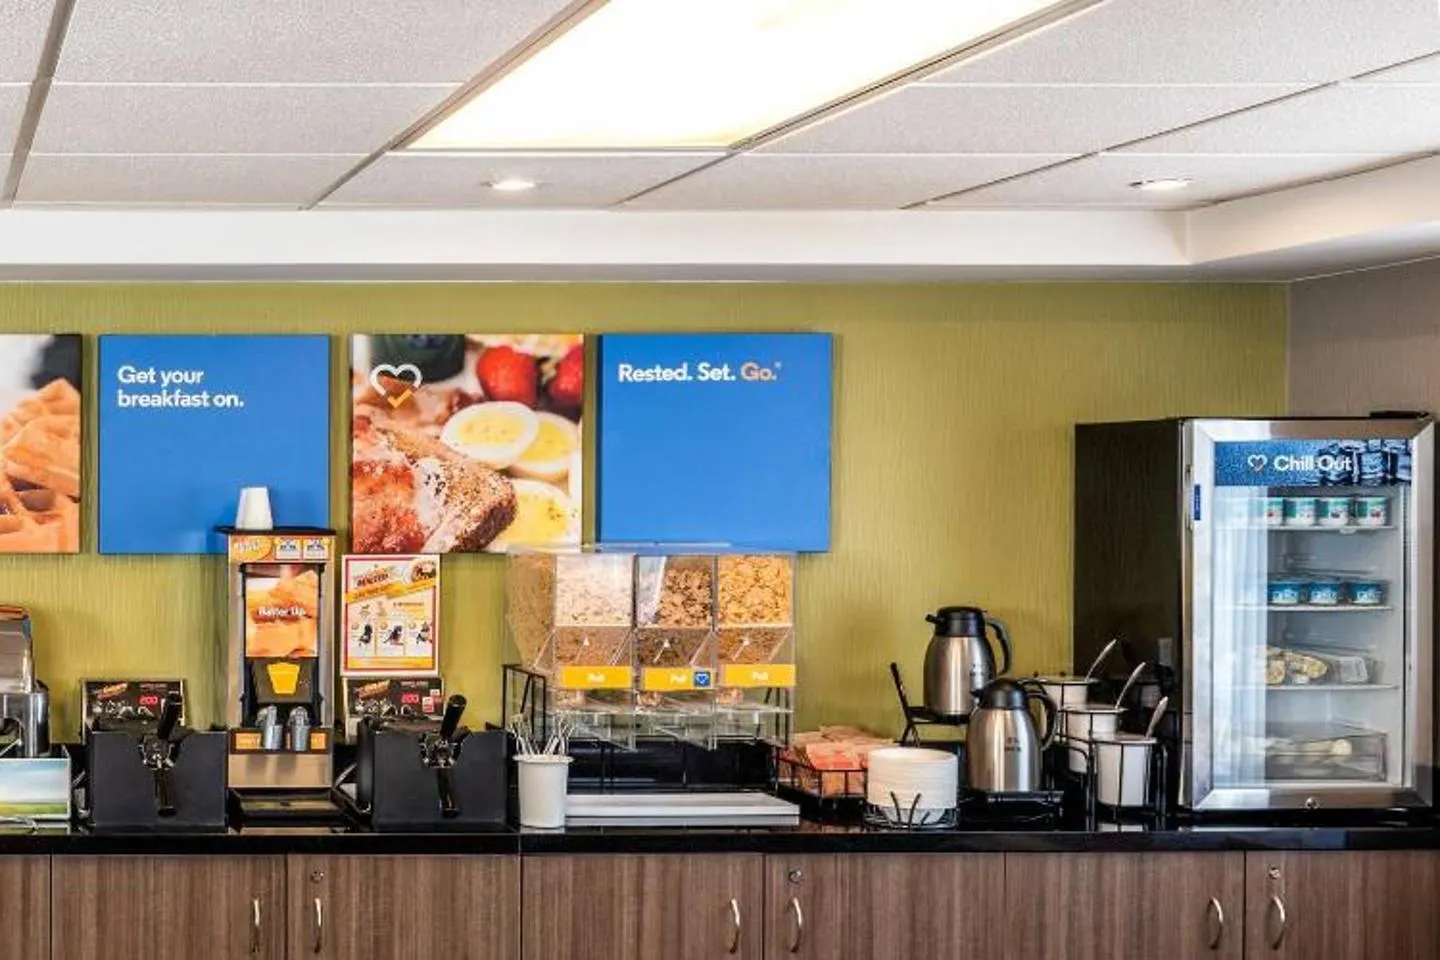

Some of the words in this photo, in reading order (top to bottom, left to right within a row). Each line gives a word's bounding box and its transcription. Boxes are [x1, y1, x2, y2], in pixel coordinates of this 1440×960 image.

[117, 365, 157, 384] Get
[160, 369, 205, 388] your
[618, 362, 693, 382] Rested.
[697, 362, 736, 381] Set.
[117, 389, 210, 407] breakfast
[212, 394, 245, 408] on.
[1273, 454, 1314, 472] Chill
[1317, 454, 1353, 472] Out
